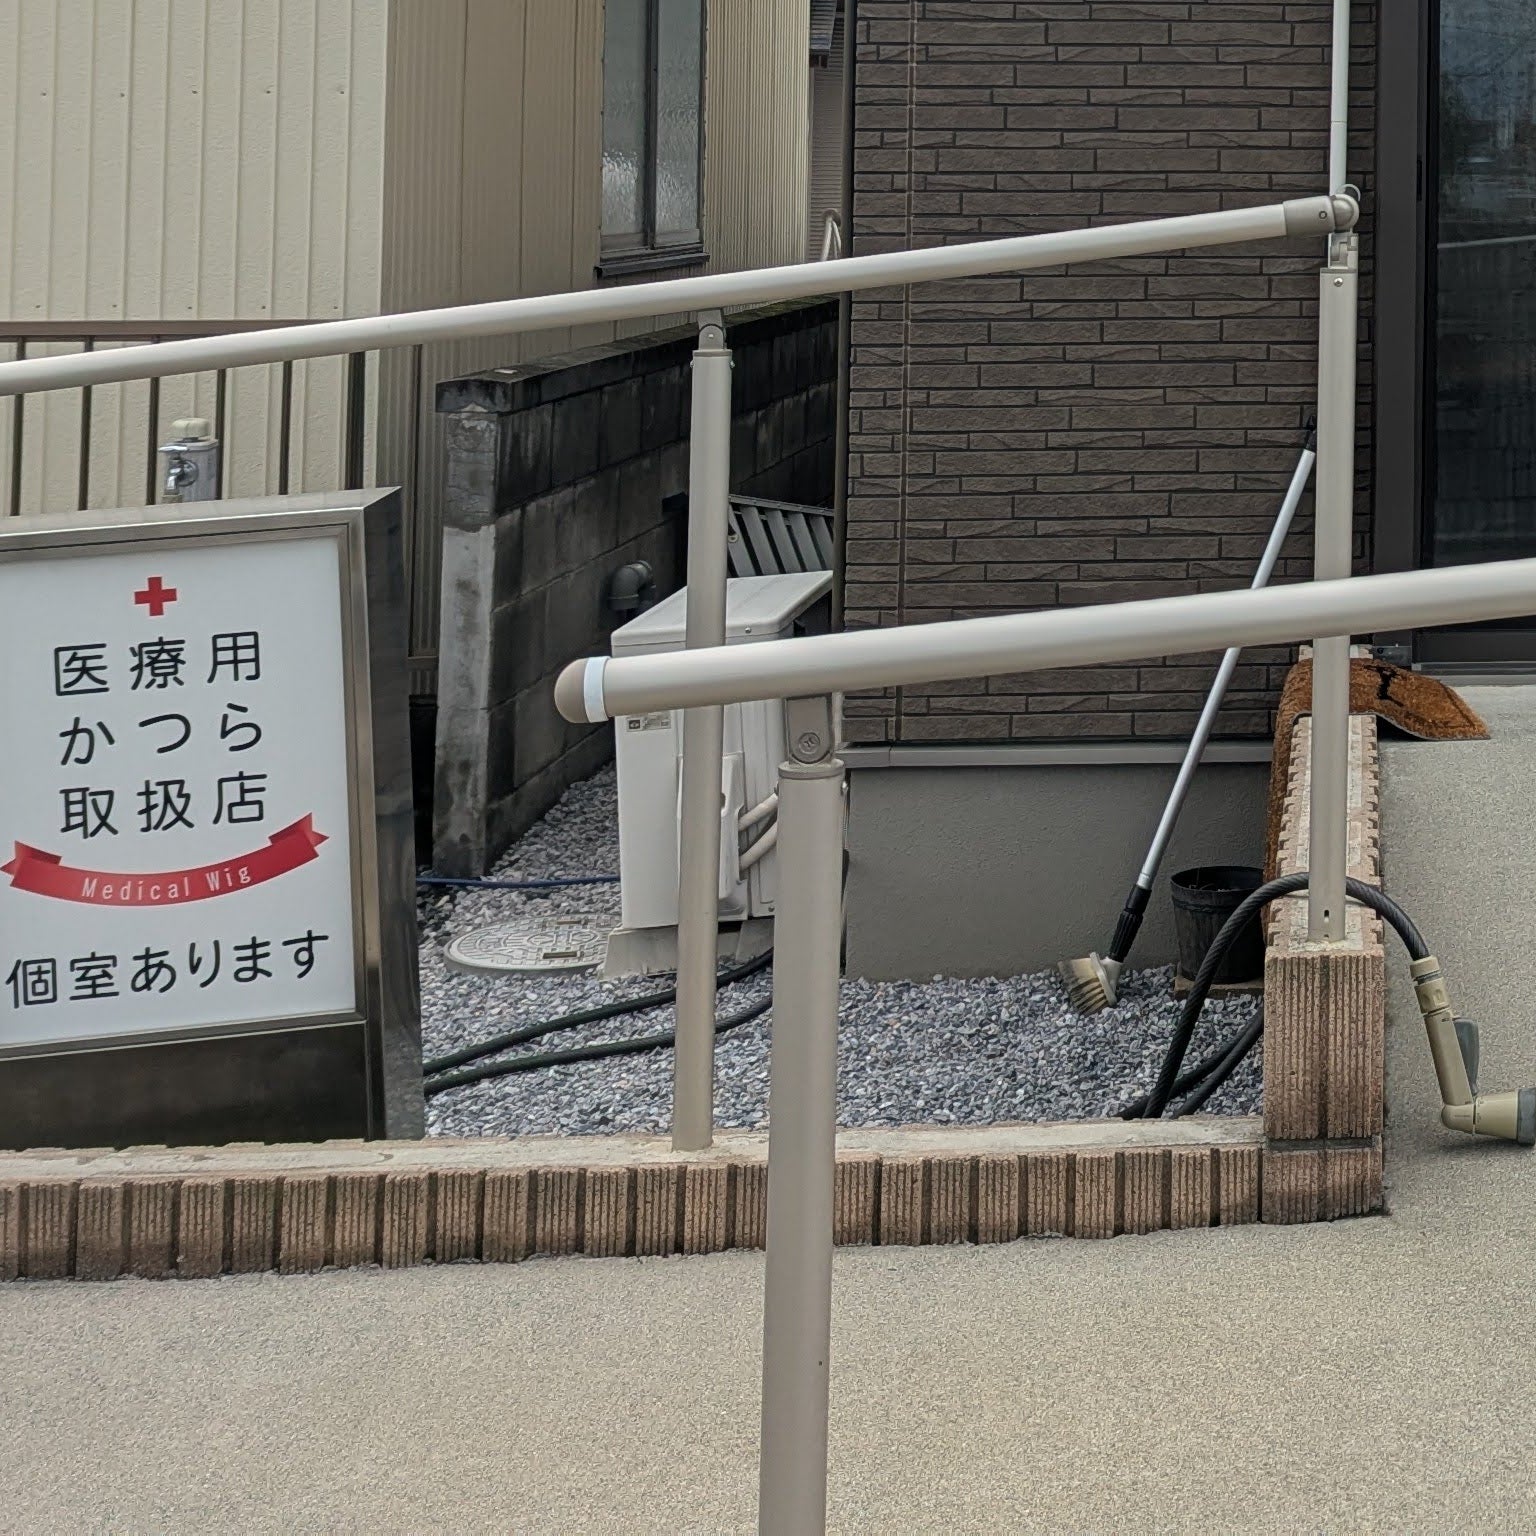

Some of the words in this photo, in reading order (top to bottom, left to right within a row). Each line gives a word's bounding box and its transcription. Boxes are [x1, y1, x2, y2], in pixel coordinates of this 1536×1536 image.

[53, 631, 262, 697] 医療用
[59, 703, 263, 766] かつら
[59, 771, 268, 839] 取扱店
[81, 875, 190, 901] Medical
[205, 865, 252, 892] Wig
[5, 929, 330, 1009] 個室あります
